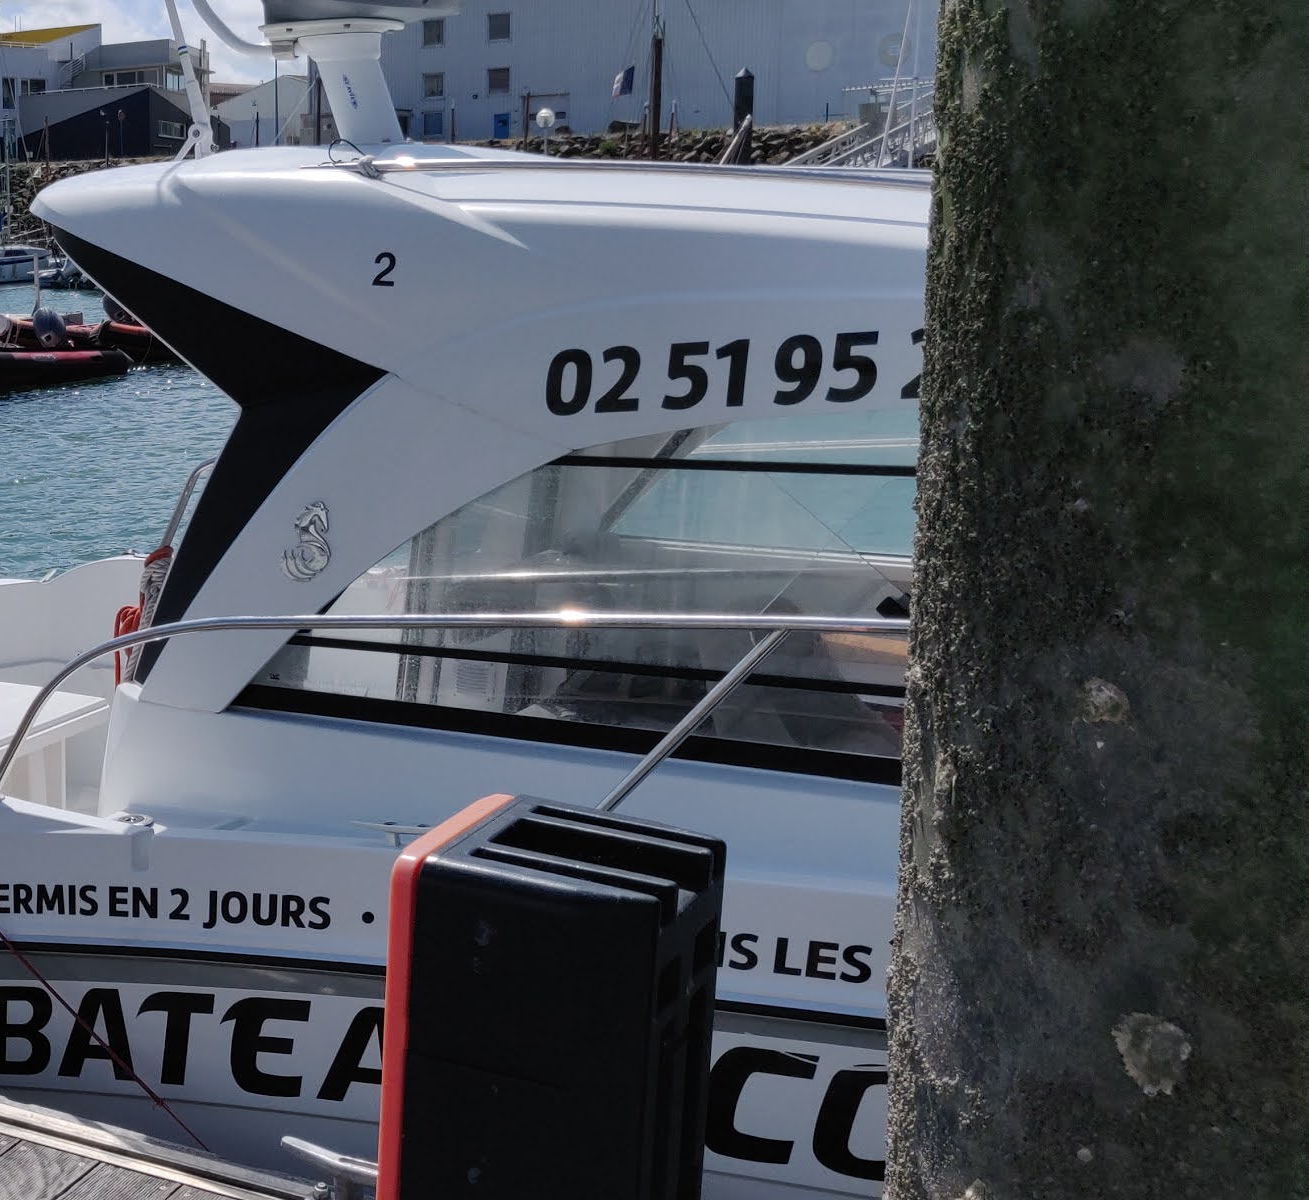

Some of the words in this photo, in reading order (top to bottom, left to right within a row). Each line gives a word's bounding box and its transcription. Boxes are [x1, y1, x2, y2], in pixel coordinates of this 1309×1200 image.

[372, 252, 396, 287] 2
[545, 344, 641, 416] 02
[661, 338, 750, 411] 51
[773, 331, 879, 406] 95
[108, 886, 159, 919] EN
[169, 888, 190, 921] 2
[203, 890, 332, 930] JOURS
[773, 936, 873, 984] LES
